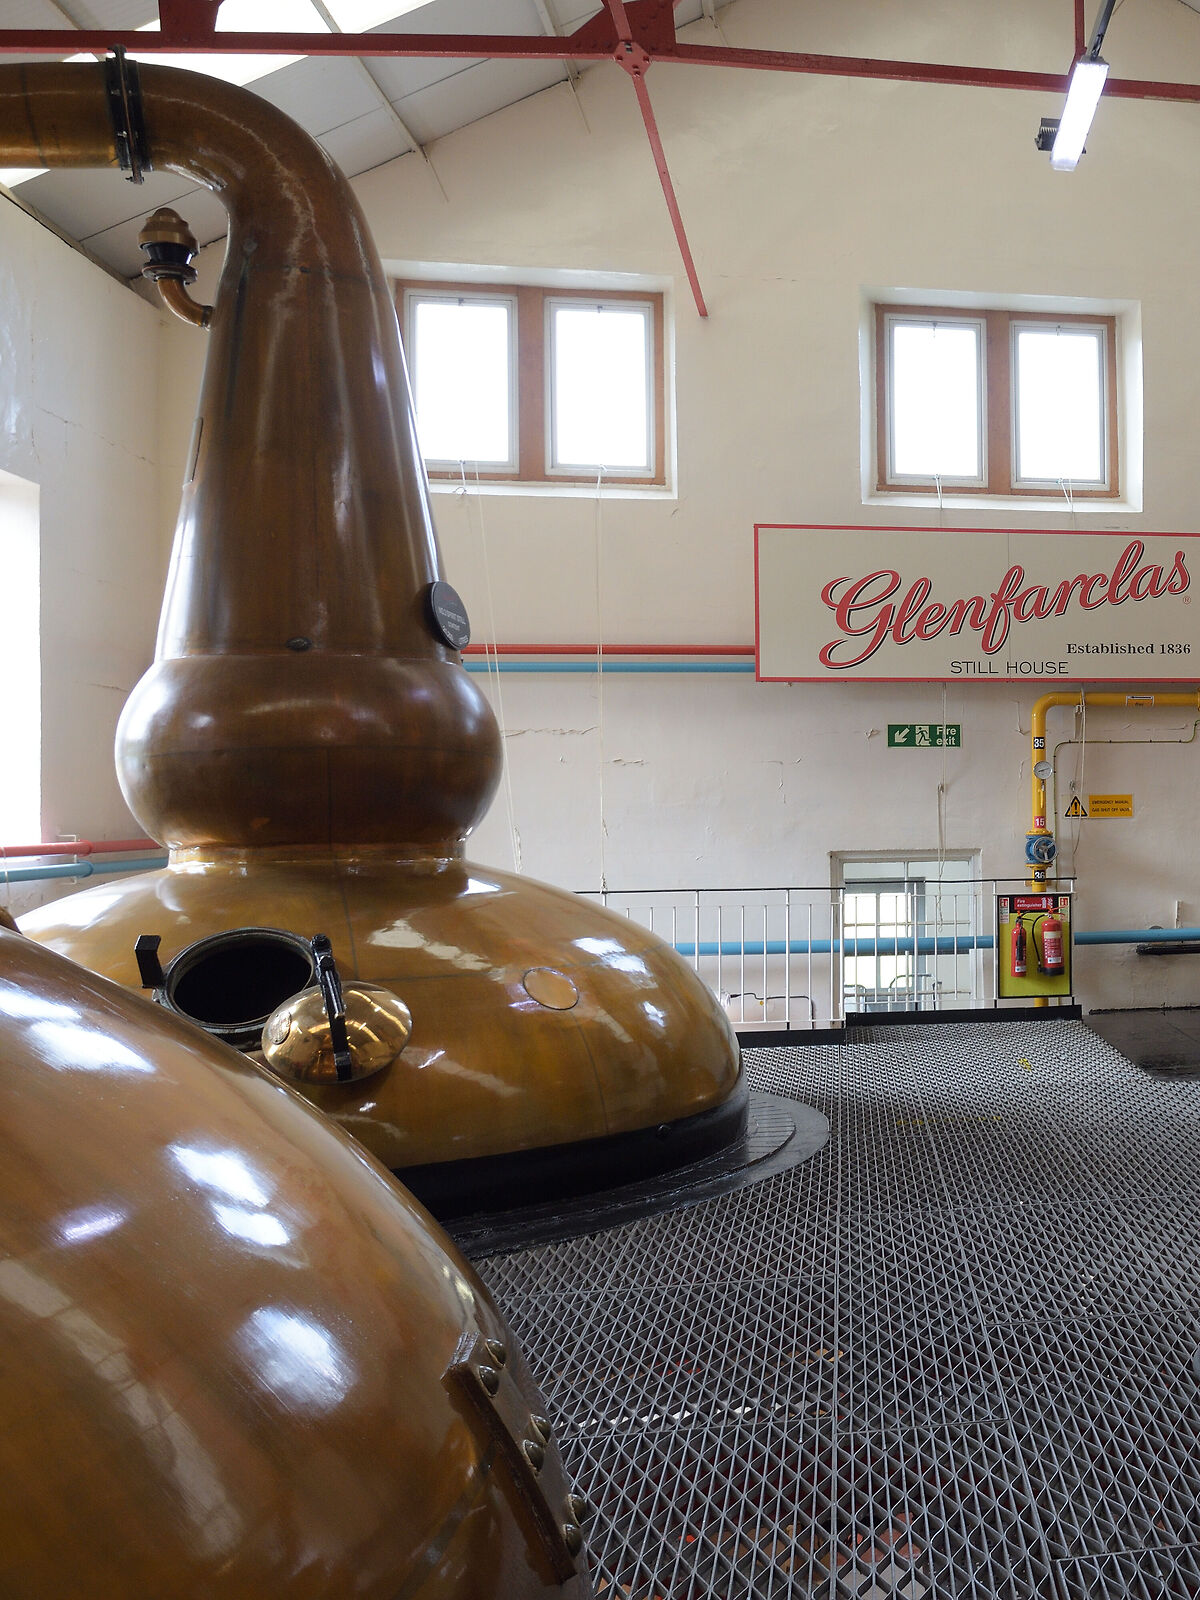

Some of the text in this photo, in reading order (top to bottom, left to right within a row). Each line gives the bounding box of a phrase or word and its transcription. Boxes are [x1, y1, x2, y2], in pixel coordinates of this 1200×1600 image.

[818, 539, 1192, 670] Glenfarclas
[1067, 642, 1191, 655] Established 1836
[950, 660, 1069, 675] STILL HOUSE
[936, 726, 957, 736] Fire
[936, 736, 956, 746] exit
[1034, 738, 1045, 748] 35
[1035, 817, 1045, 827] 15
